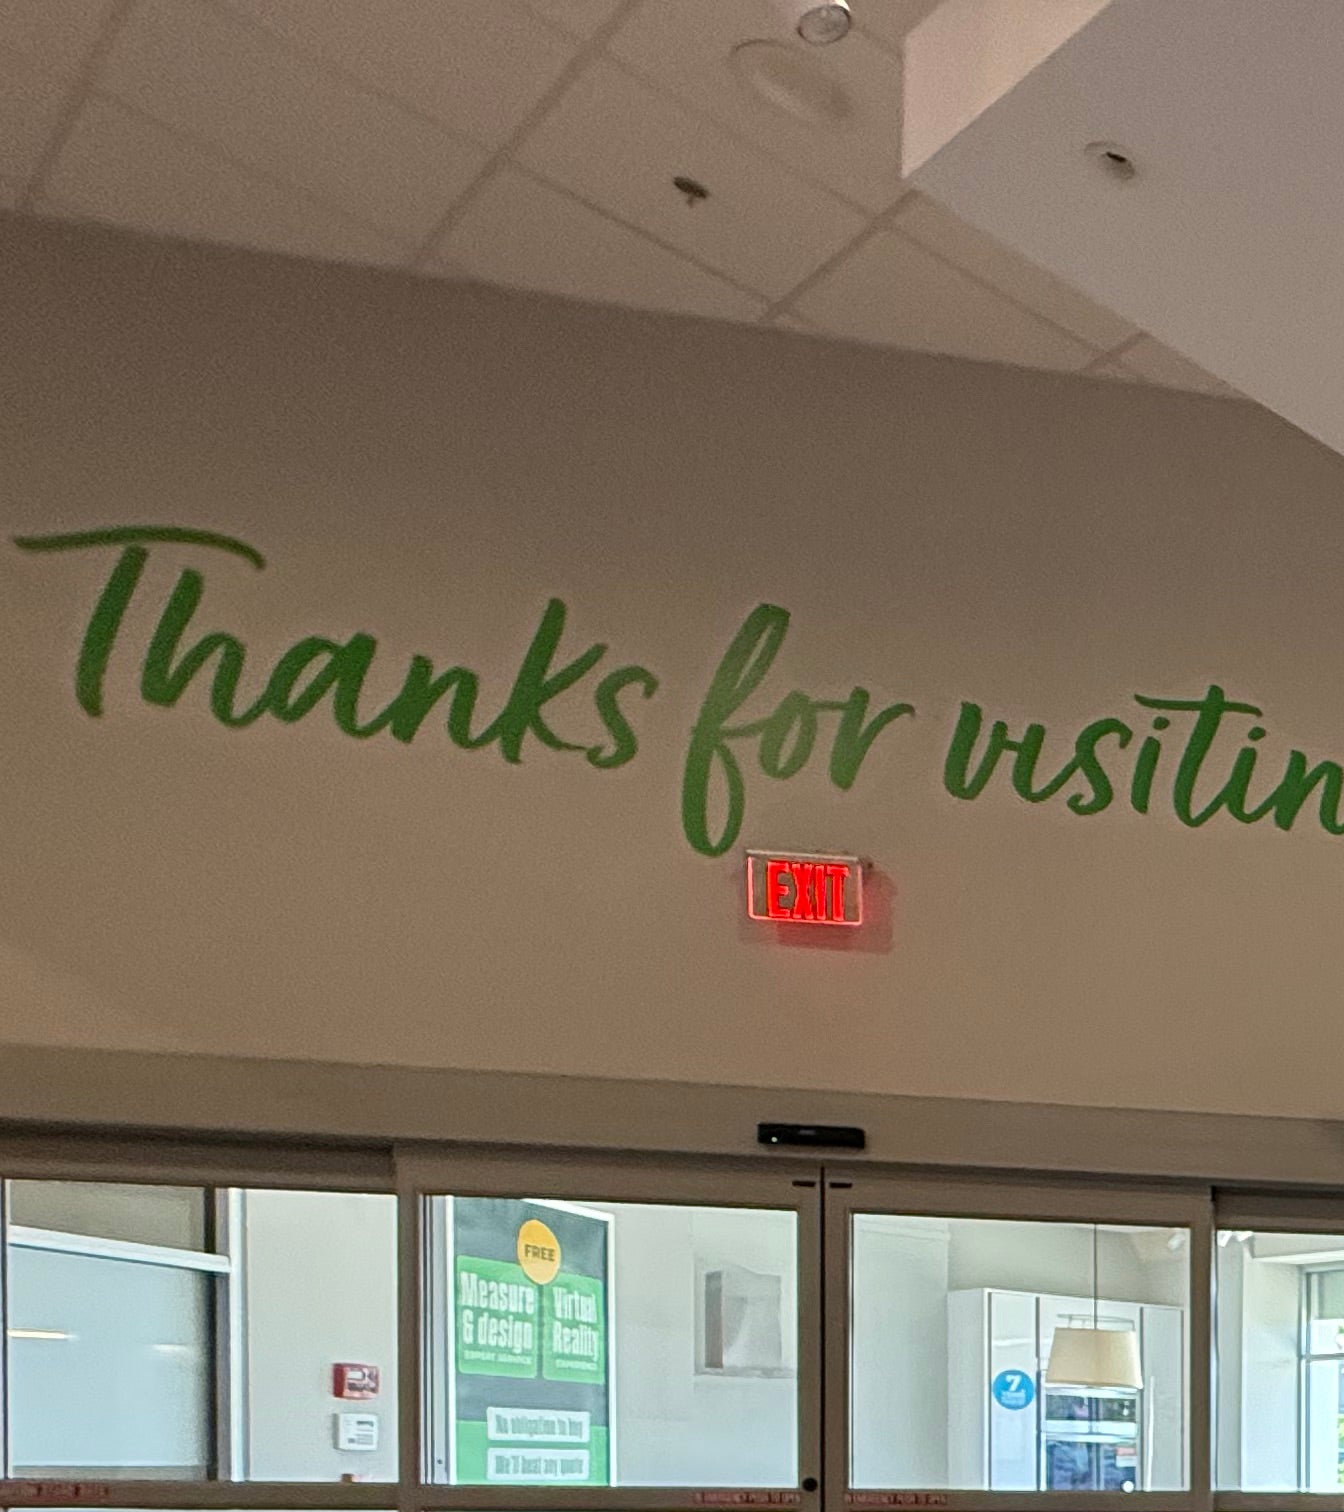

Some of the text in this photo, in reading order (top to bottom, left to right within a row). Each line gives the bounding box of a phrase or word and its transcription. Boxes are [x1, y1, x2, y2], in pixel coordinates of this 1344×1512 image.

[13, 525, 659, 769] Thanks
[681, 602, 916, 857] for
[767, 861, 850, 921] EXIT
[524, 1244, 556, 1262] FREE
[460, 1271, 535, 1315] Measure
[552, 1286, 597, 1323] Virtual
[462, 1309, 533, 1354] & design
[552, 1320, 599, 1361] Reality
